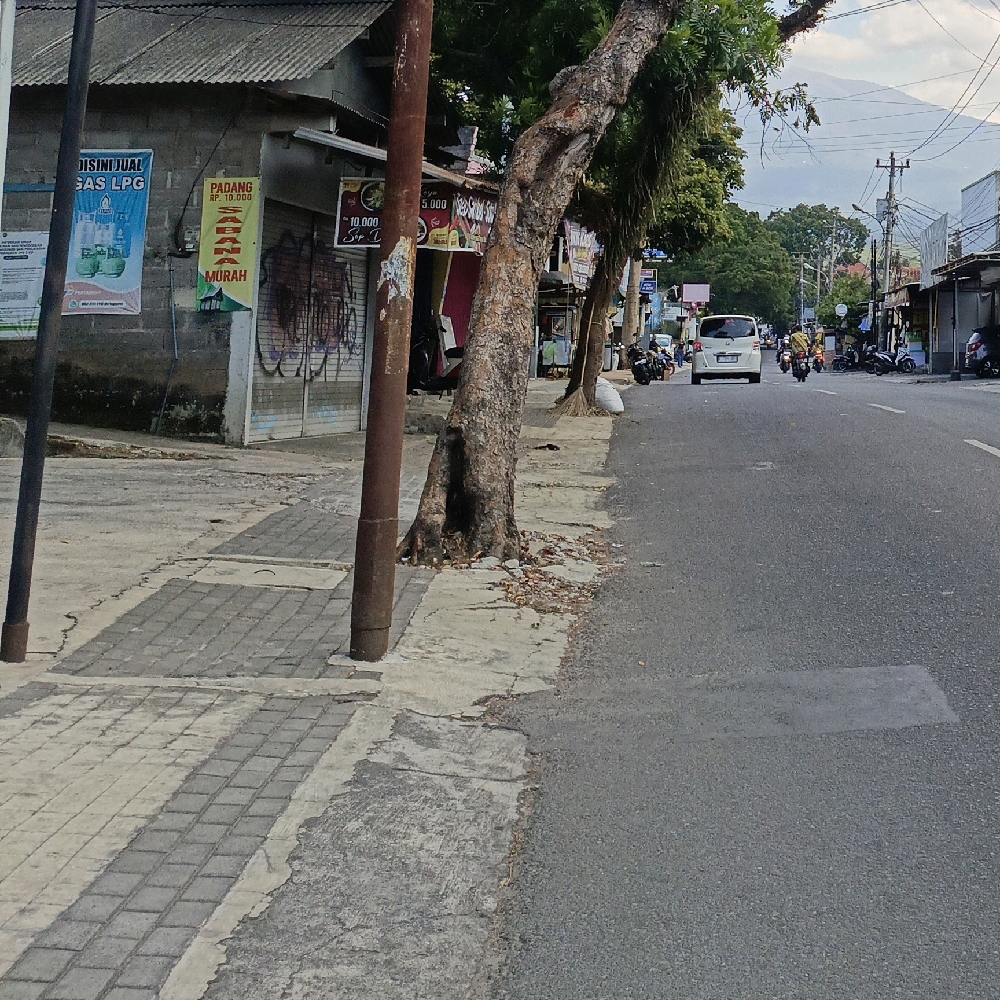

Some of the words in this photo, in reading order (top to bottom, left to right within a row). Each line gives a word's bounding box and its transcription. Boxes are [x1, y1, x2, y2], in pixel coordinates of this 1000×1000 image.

[115, 158, 142, 172] JUAL
[111, 176, 145, 191] LPG
[210, 182, 253, 193] PADANG
[225, 193, 252, 201] 10.000
[350, 216, 379, 227] 10.000
[214, 206, 242, 265] SABANA
[205, 269, 248, 282] MURAH
